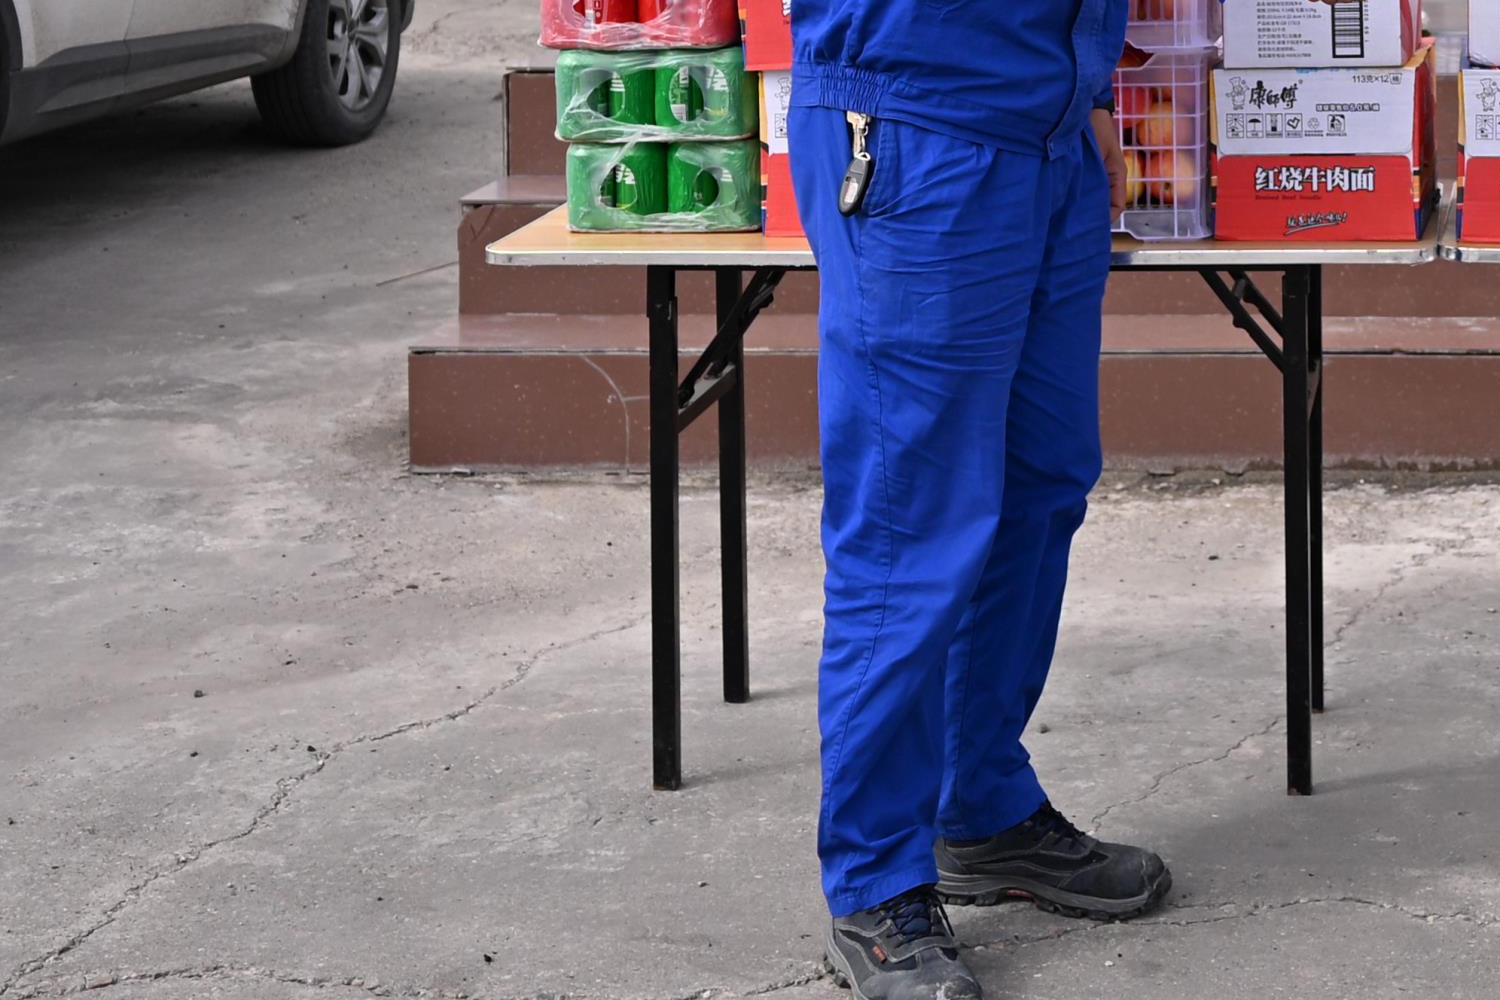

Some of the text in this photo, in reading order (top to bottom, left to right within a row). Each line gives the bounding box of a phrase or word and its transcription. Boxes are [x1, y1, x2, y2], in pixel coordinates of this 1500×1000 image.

[1249, 80, 1299, 110] 康師傅
[1255, 166, 1375, 192] 红烧牛肉面
